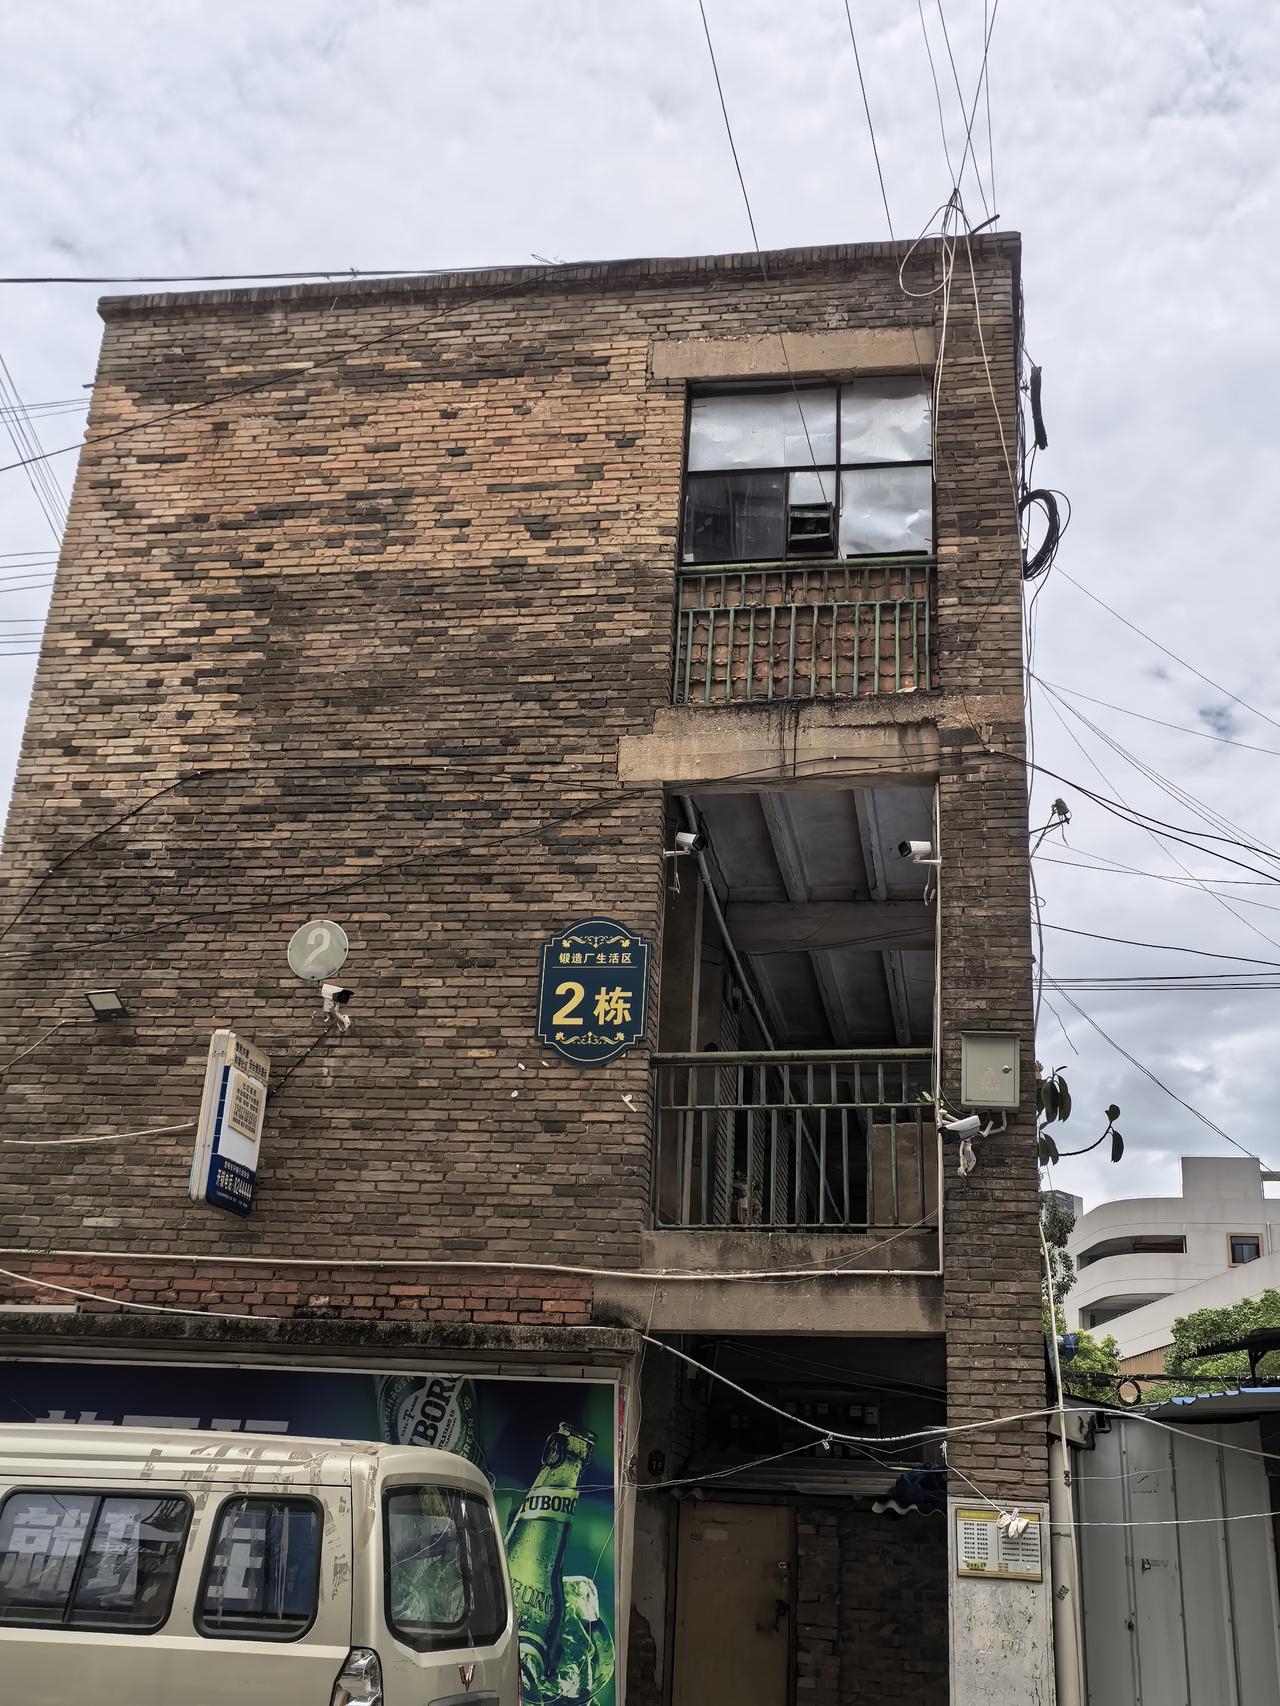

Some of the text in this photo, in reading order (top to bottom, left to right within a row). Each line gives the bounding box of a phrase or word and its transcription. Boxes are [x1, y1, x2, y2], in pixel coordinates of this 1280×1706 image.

[303, 926, 331, 972] 2
[559, 952, 633, 964] 锻造厂生活区
